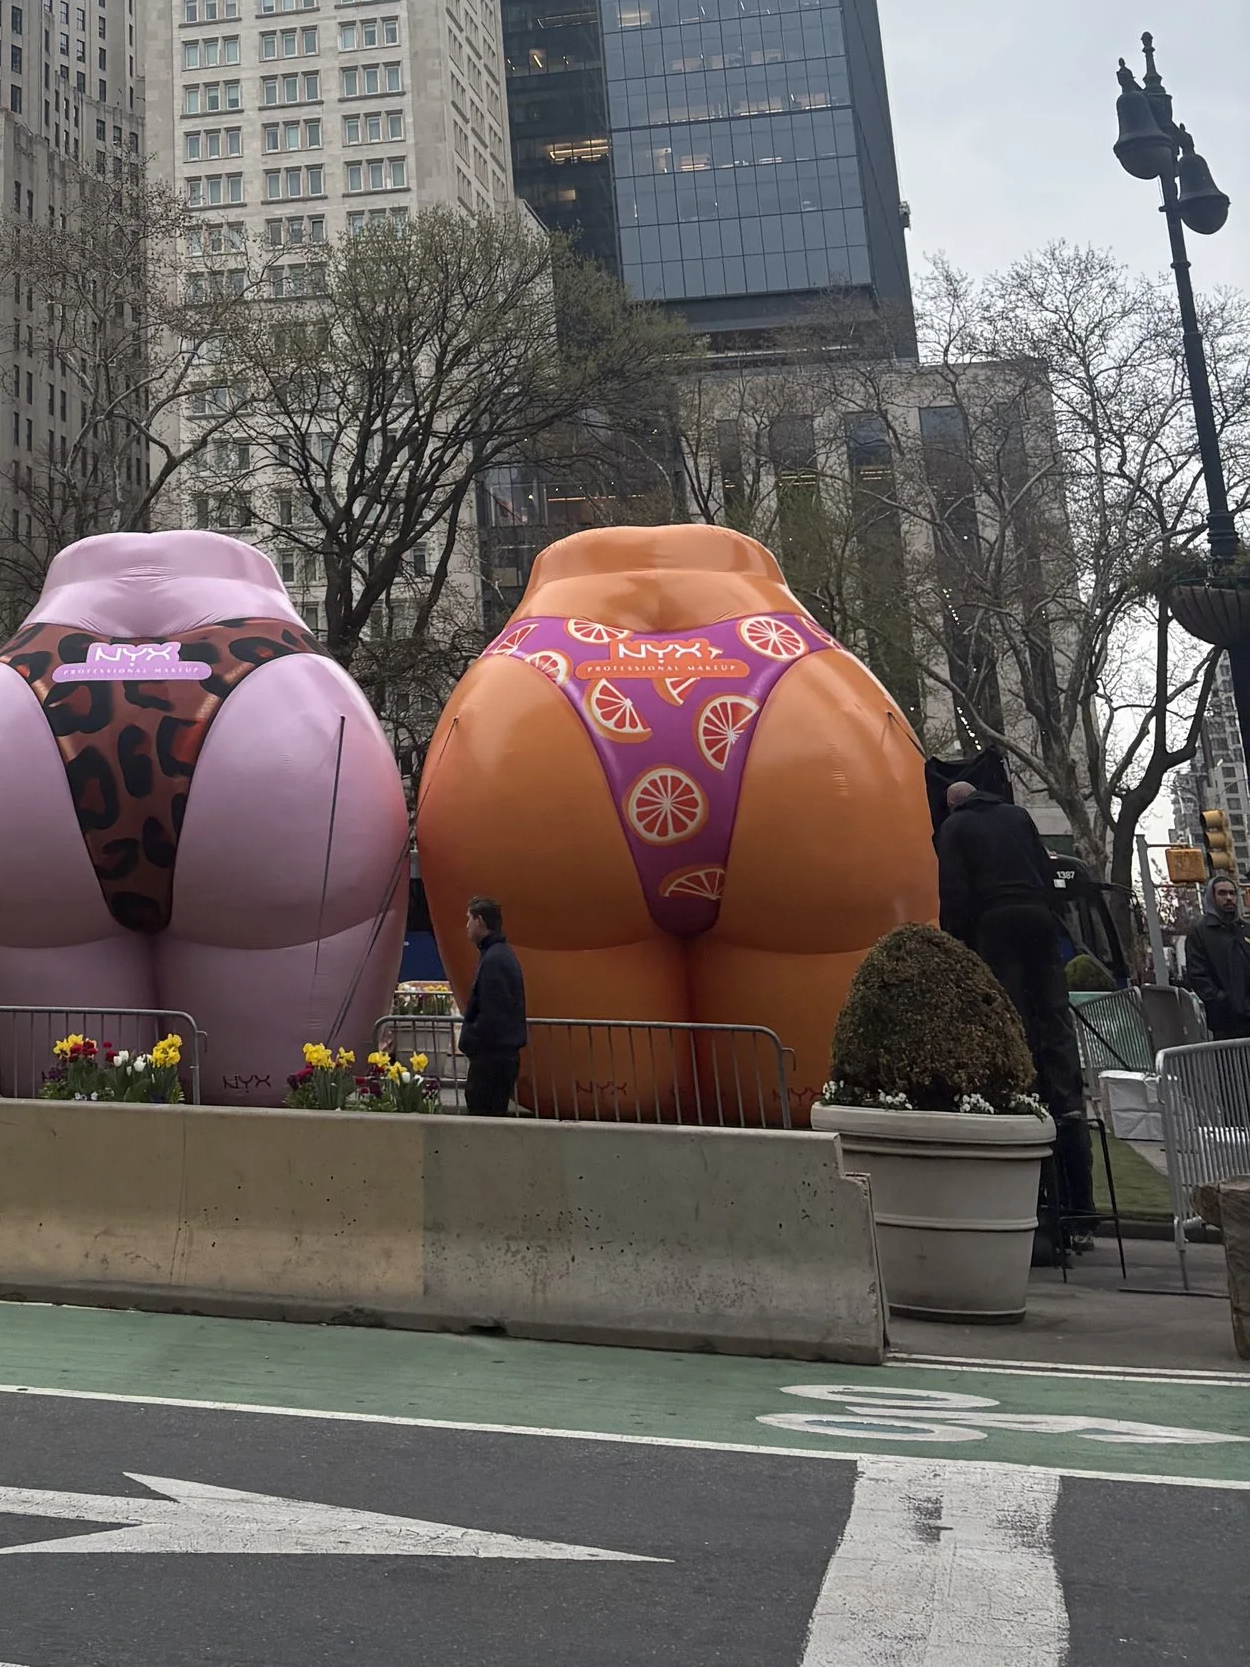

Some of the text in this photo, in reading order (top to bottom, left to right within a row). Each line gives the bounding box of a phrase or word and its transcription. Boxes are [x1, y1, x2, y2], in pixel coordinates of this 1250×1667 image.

[94, 646, 173, 667] NYX
[618, 642, 702, 664] NYX
[63, 666, 199, 675] PROFESSIONAL MAKEUP
[1056, 870, 1075, 879] 1387
[222, 1074, 271, 1093] NYX
